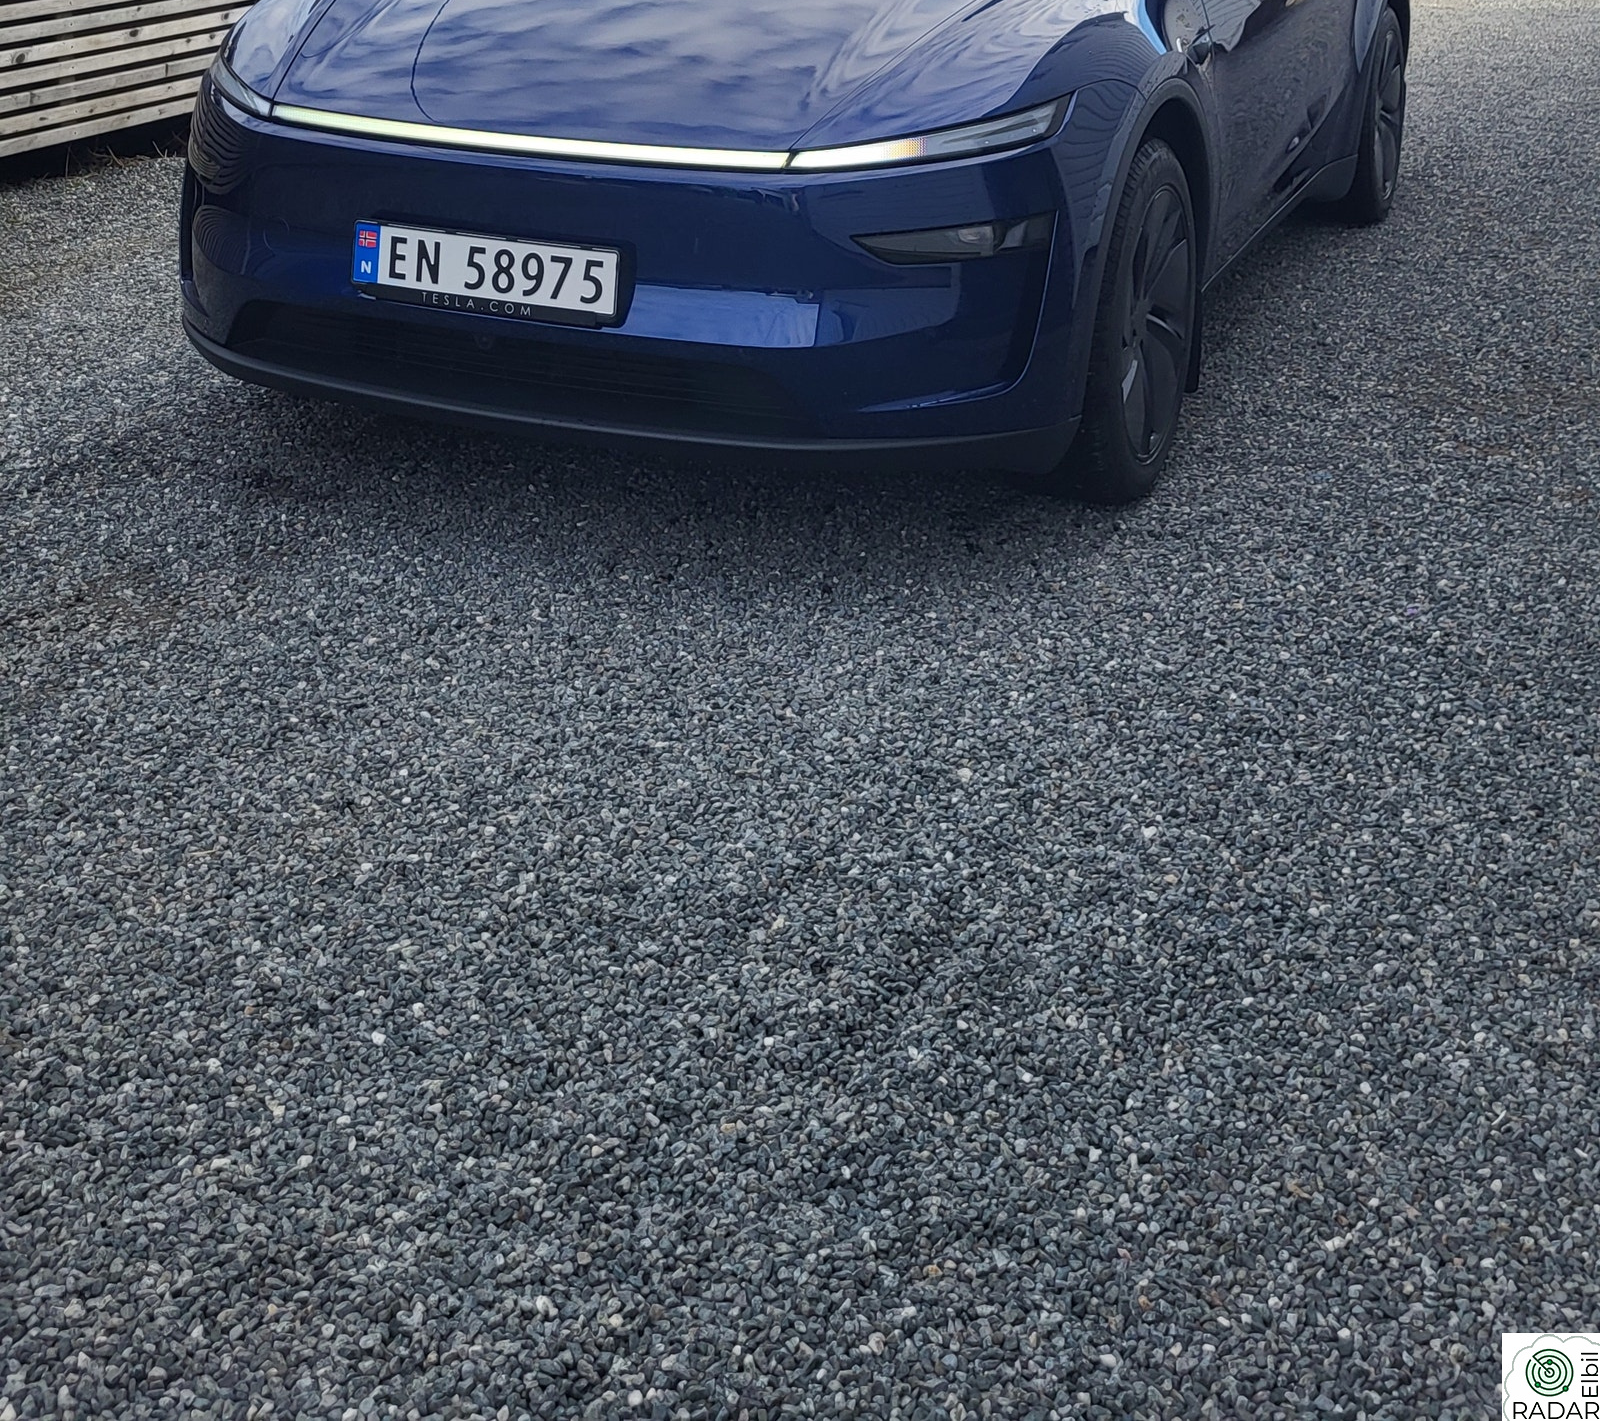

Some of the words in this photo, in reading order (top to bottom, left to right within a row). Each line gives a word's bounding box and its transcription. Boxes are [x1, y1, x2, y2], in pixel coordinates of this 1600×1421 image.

[360, 260, 372, 274] N
[388, 235, 441, 285] EN
[463, 245, 604, 304] 58975
[421, 291, 532, 316] TESLA.COM
